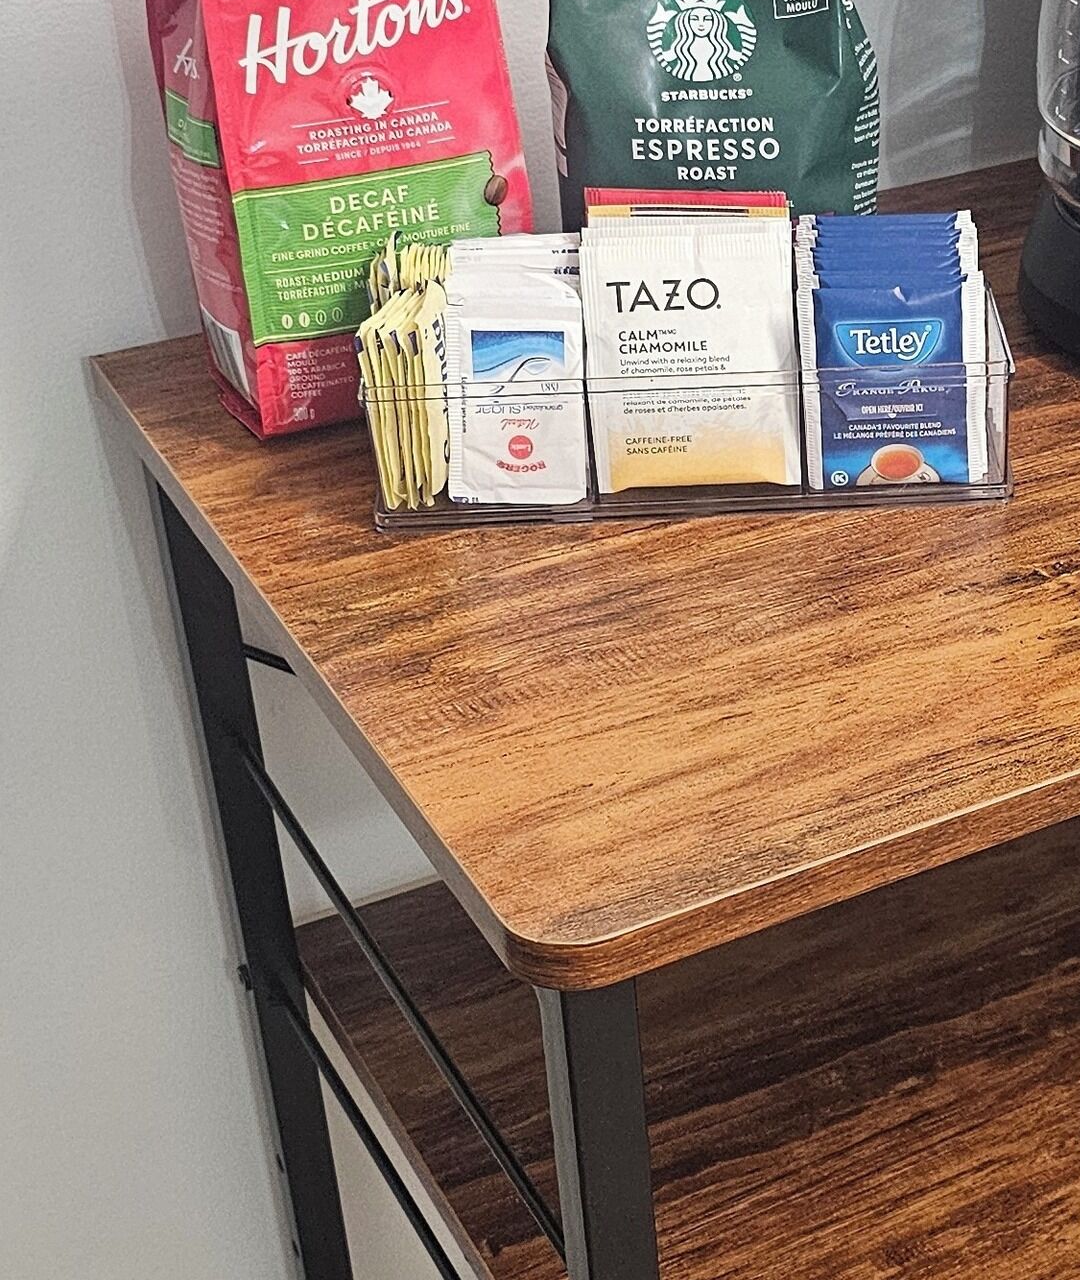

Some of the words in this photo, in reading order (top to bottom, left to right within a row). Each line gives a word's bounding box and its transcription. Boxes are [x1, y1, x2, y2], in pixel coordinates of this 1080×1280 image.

[786, 0, 818, 13] MOULU
[661, 88, 748, 102] STARBUCKS
[308, 124, 372, 141] ROASTING
[375, 119, 388, 131] IN
[391, 111, 439, 129] CANADA
[635, 115, 774, 133] TORRÉFACTION
[296, 133, 386, 155] TORRÉFACTION
[388, 129, 403, 141] AU
[406, 120, 452, 138] CANADA
[335, 150, 362, 162] SINCE
[369, 143, 400, 156] DEPUIS
[631, 137, 780, 161] ESPRESSO
[677, 166, 738, 181] ROAST
[329, 184, 409, 215] DECAF
[302, 198, 440, 241] DÉCAFÉINÉ
[402, 227, 450, 243] MOUTURE
[450, 222, 471, 234] FINE
[272, 248, 295, 263] FINE
[296, 244, 330, 260] GRIND
[332, 240, 369, 256] COFFEE
[276, 275, 310, 289] ROAST:
[311, 267, 365, 283] MEDIUM
[277, 279, 347, 301] TORRÉFACTION
[606, 278, 720, 313] TAZO
[619, 340, 708, 355] CHAMOMILE
[850, 324, 932, 361] Tetley
[620, 357, 650, 367] Unwind
[651, 356, 669, 365] with
[677, 356, 707, 366] relaxing
[708, 355, 730, 363] blend
[620, 367, 630, 375] of
[631, 365, 675, 375] chamomile,
[676, 365, 693, 374] rose
[695, 363, 719, 373] petals
[720, 363, 726, 371] &
[623, 407, 633, 415] de
[634, 407, 656, 415] roses
[657, 406, 666, 414] et
[667, 404, 700, 413] d'herbes
[861, 405, 877, 415] OPEN
[882, 422, 919, 430] FAVOURITE
[919, 428, 956, 437] CANADIENS
[625, 435, 692, 445] CAFFEINE-FREE
[626, 446, 650, 456] SANS
[650, 445, 688, 455] CAFÉINE
